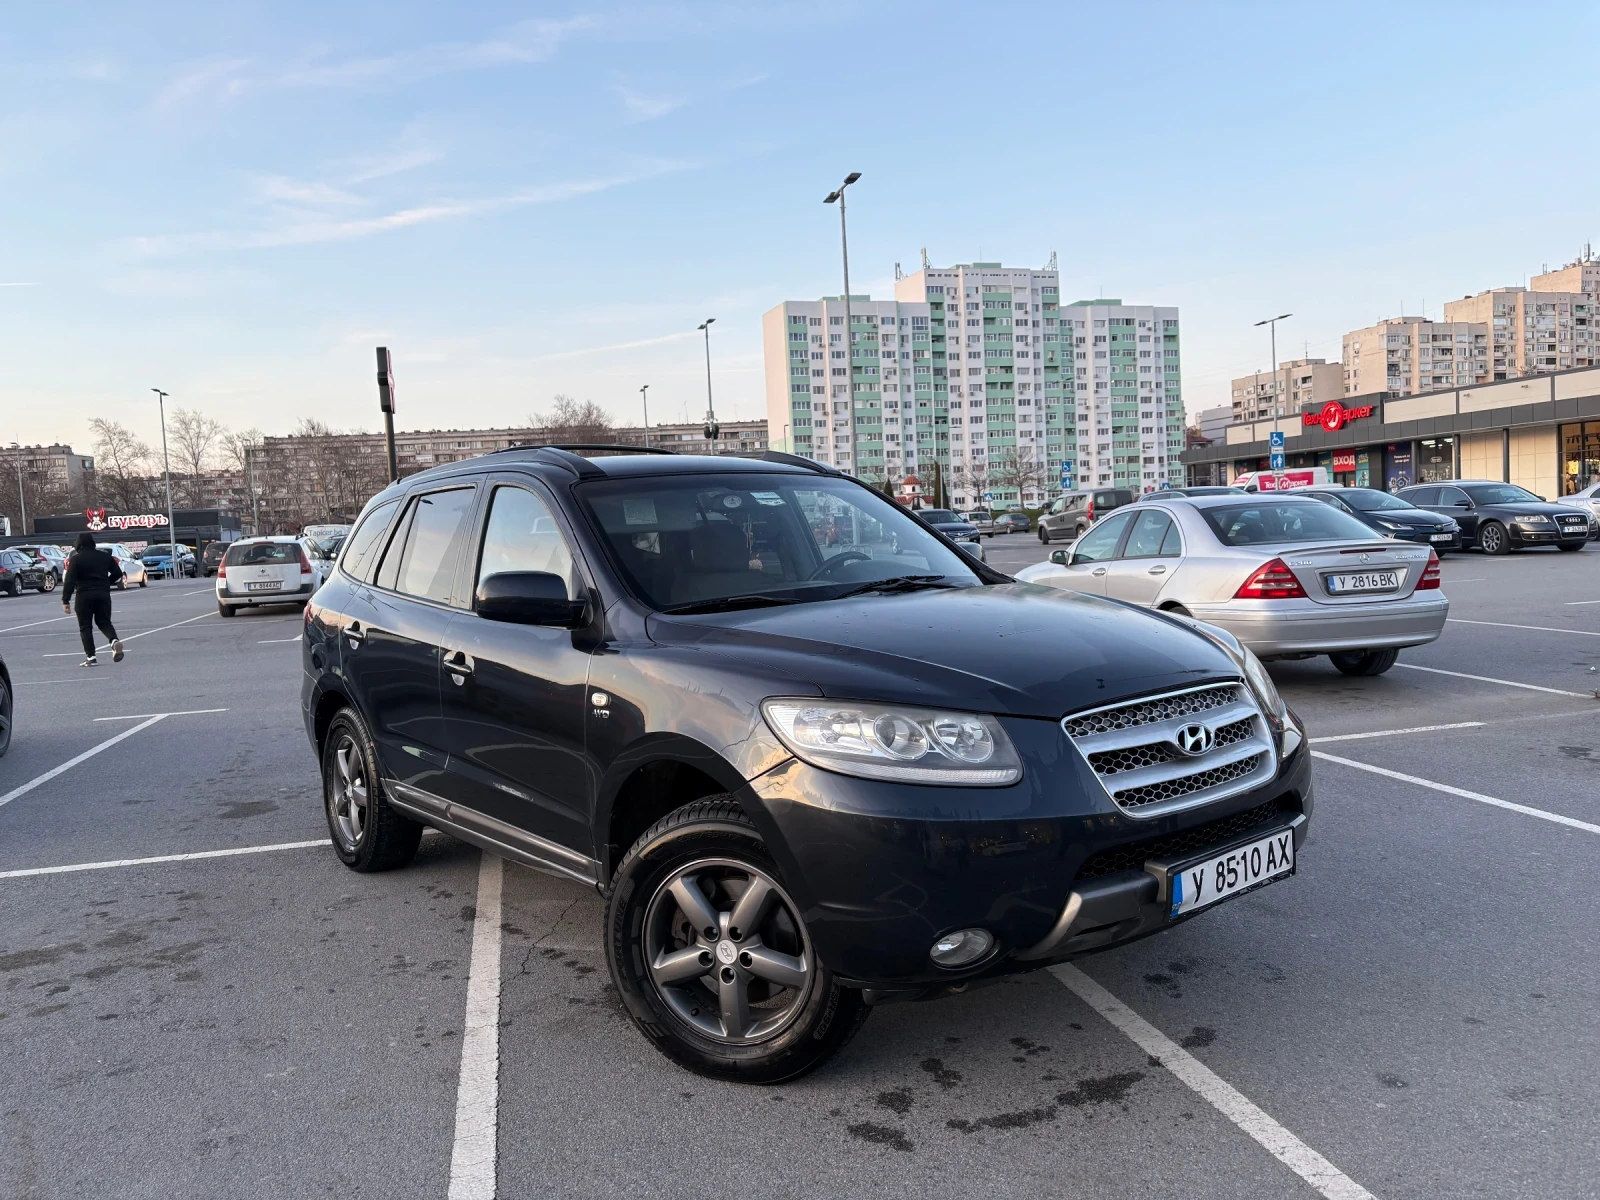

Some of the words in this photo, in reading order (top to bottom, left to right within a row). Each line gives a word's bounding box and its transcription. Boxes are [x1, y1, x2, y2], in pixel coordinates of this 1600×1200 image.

[1333, 455, 1356, 465] ВХОД
[1352, 574, 1378, 588] 2816
[1215, 847, 1261, 893] 8510
[1266, 834, 1290, 873] AX
